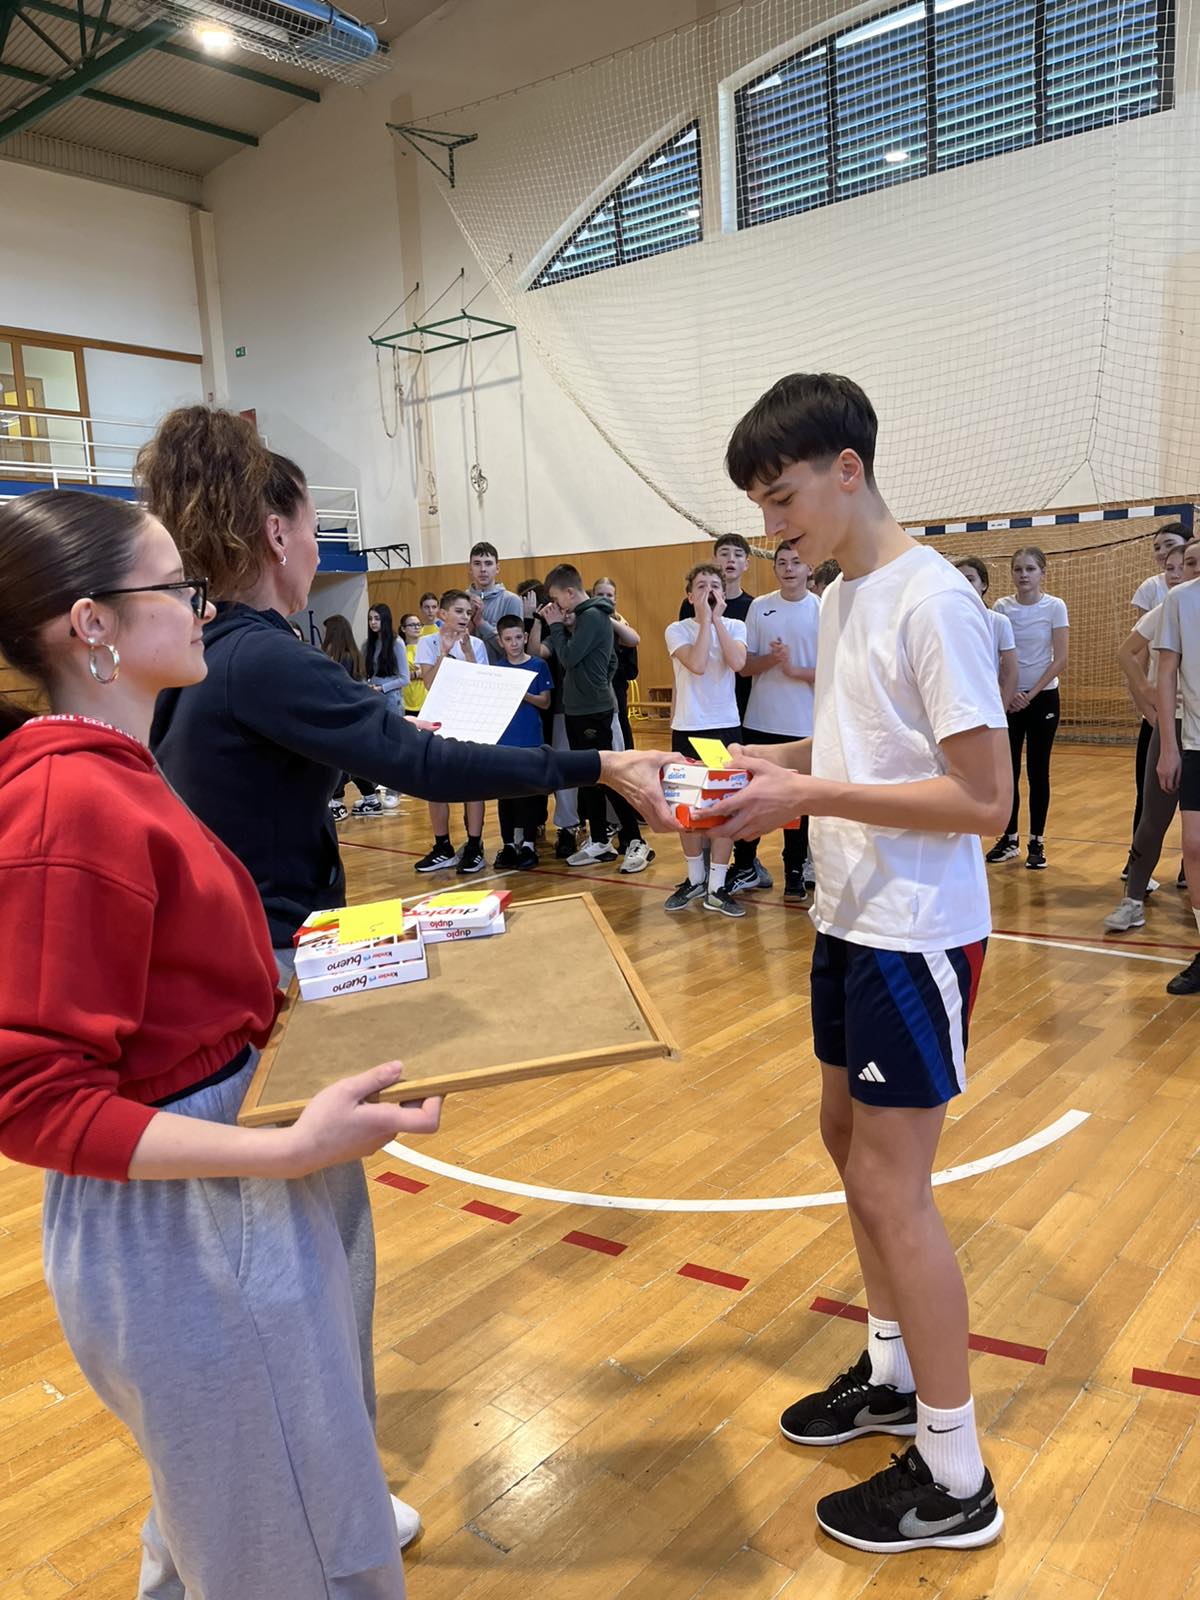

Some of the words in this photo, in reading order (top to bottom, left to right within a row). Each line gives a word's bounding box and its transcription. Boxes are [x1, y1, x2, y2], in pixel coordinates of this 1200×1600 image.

[417, 907, 479, 917] duplo
[430, 919, 454, 928] duplo
[446, 928, 472, 939] duplo
[327, 953, 362, 971] bueno
[332, 975, 368, 993] bueno
